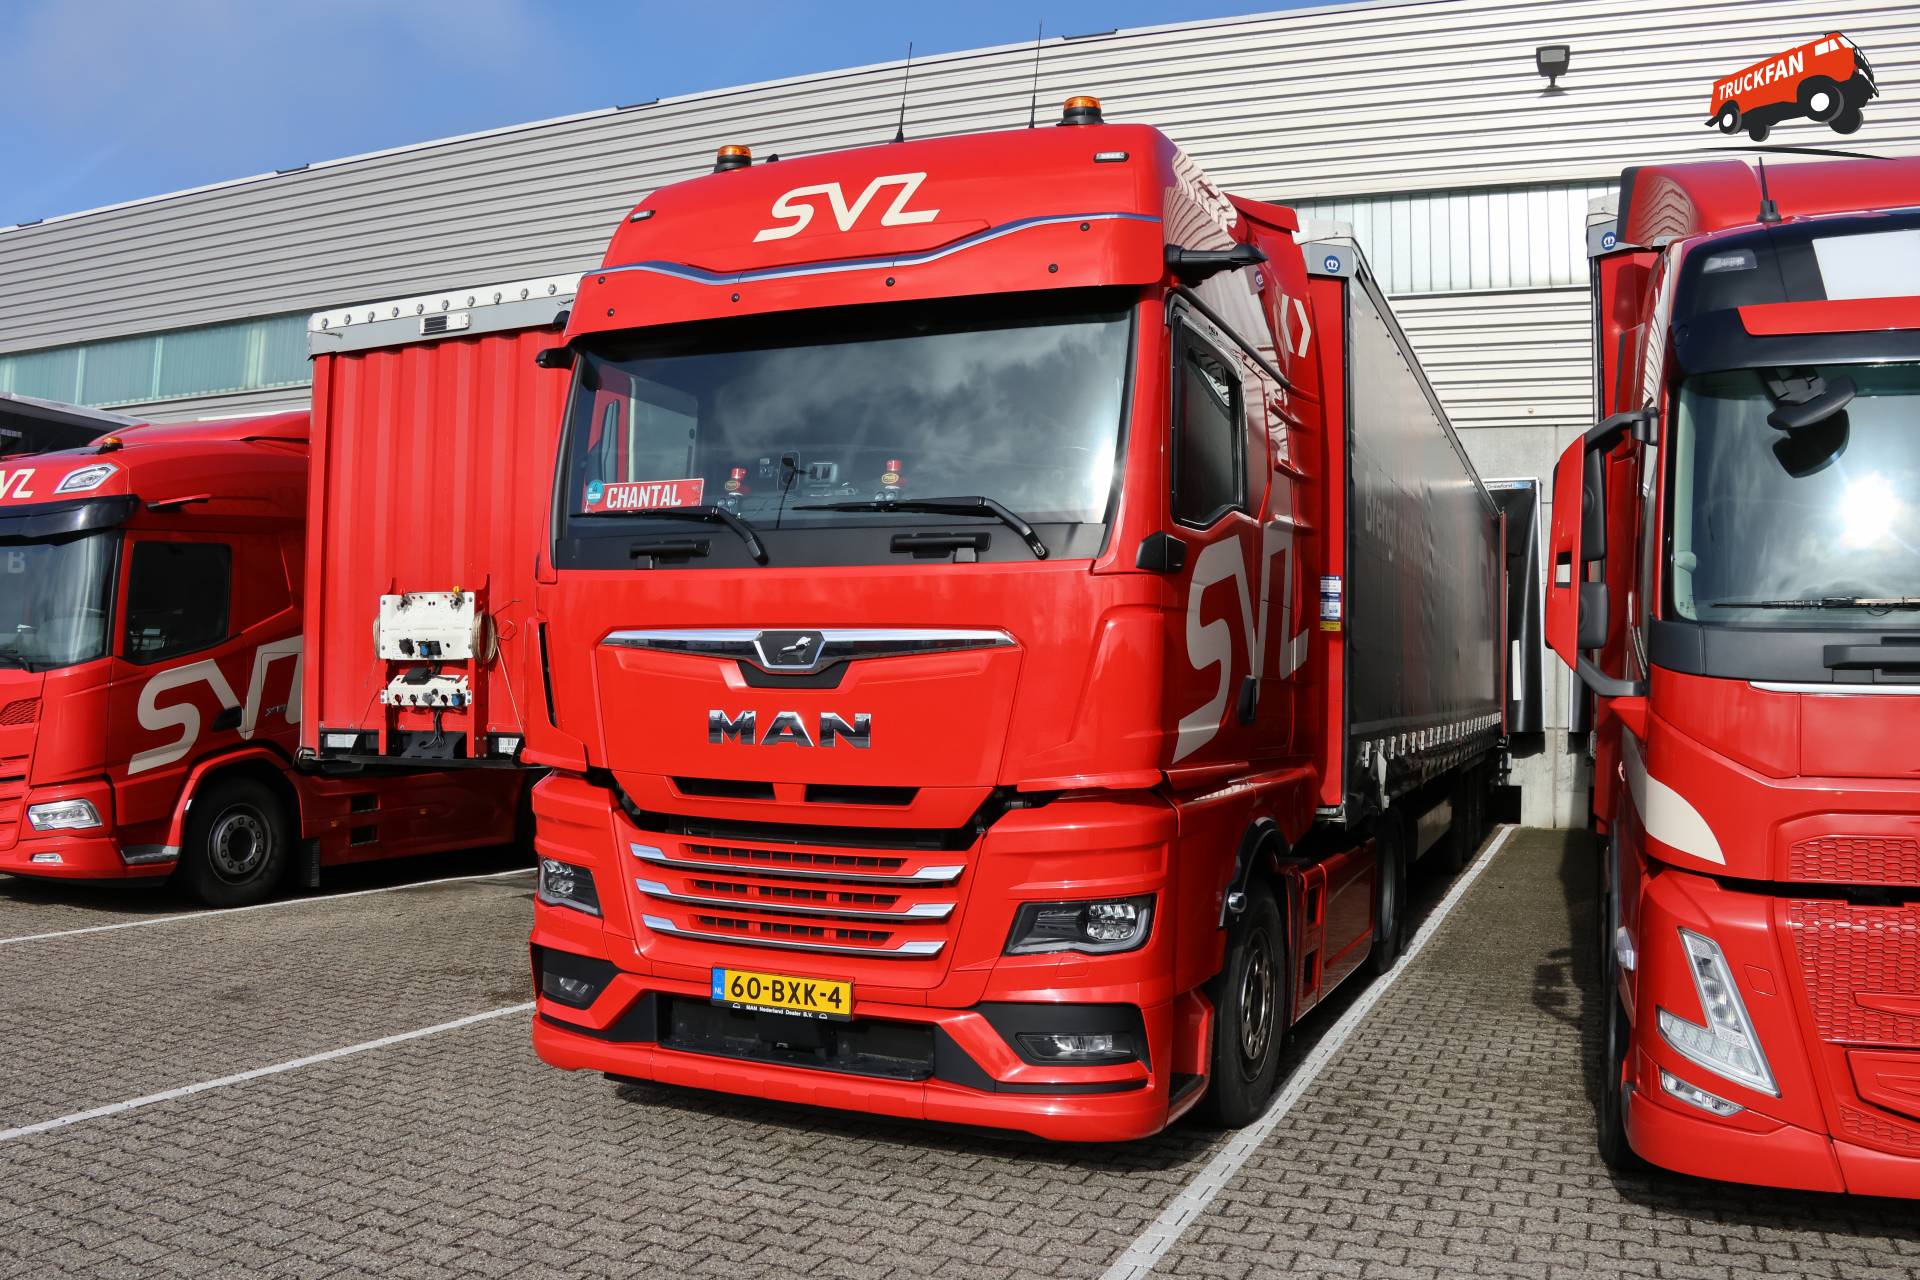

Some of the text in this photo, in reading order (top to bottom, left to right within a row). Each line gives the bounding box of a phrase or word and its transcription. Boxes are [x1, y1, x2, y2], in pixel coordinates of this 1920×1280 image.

[752, 171, 941, 242] SVZ
[0, 468, 36, 500] VZ
[606, 484, 682, 509] CHANTAL
[1171, 516, 1310, 764] SVZ
[708, 709, 872, 749] MAN
[714, 986, 724, 995] NL
[730, 975, 843, 1009] 60-BXK-4
[759, 1006, 784, 1015] Nederland
[785, 1009, 801, 1017] Dealer
